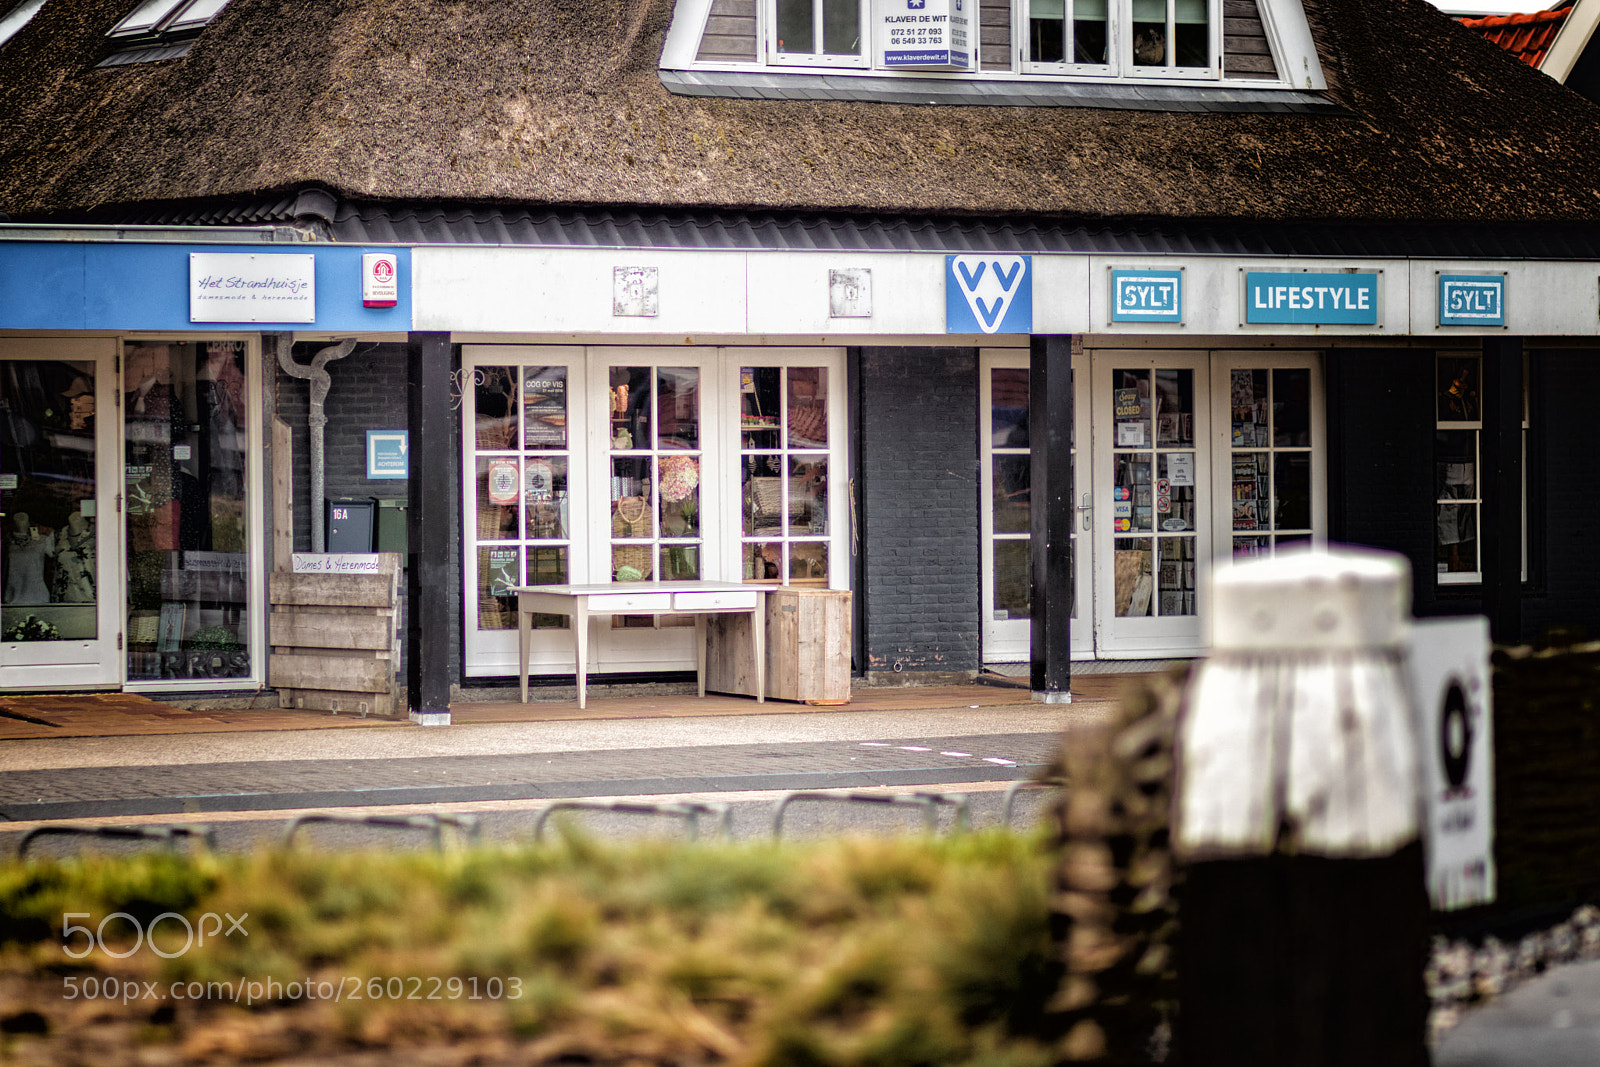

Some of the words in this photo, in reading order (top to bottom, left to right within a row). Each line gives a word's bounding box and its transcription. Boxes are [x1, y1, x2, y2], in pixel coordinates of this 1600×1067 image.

[885, 15, 917, 23] KLAVER
[198, 275, 223, 289] Het
[225, 276, 308, 293] Strandhuisje
[1123, 285, 1171, 307] SYLT
[1255, 286, 1370, 309] LIFESTYLE
[1451, 289, 1495, 311] SYLT
[1116, 405, 1140, 416] CLOSED
[296, 555, 322, 570] Dames
[326, 557, 331, 570] &
[335, 555, 379, 571] Herenmode
